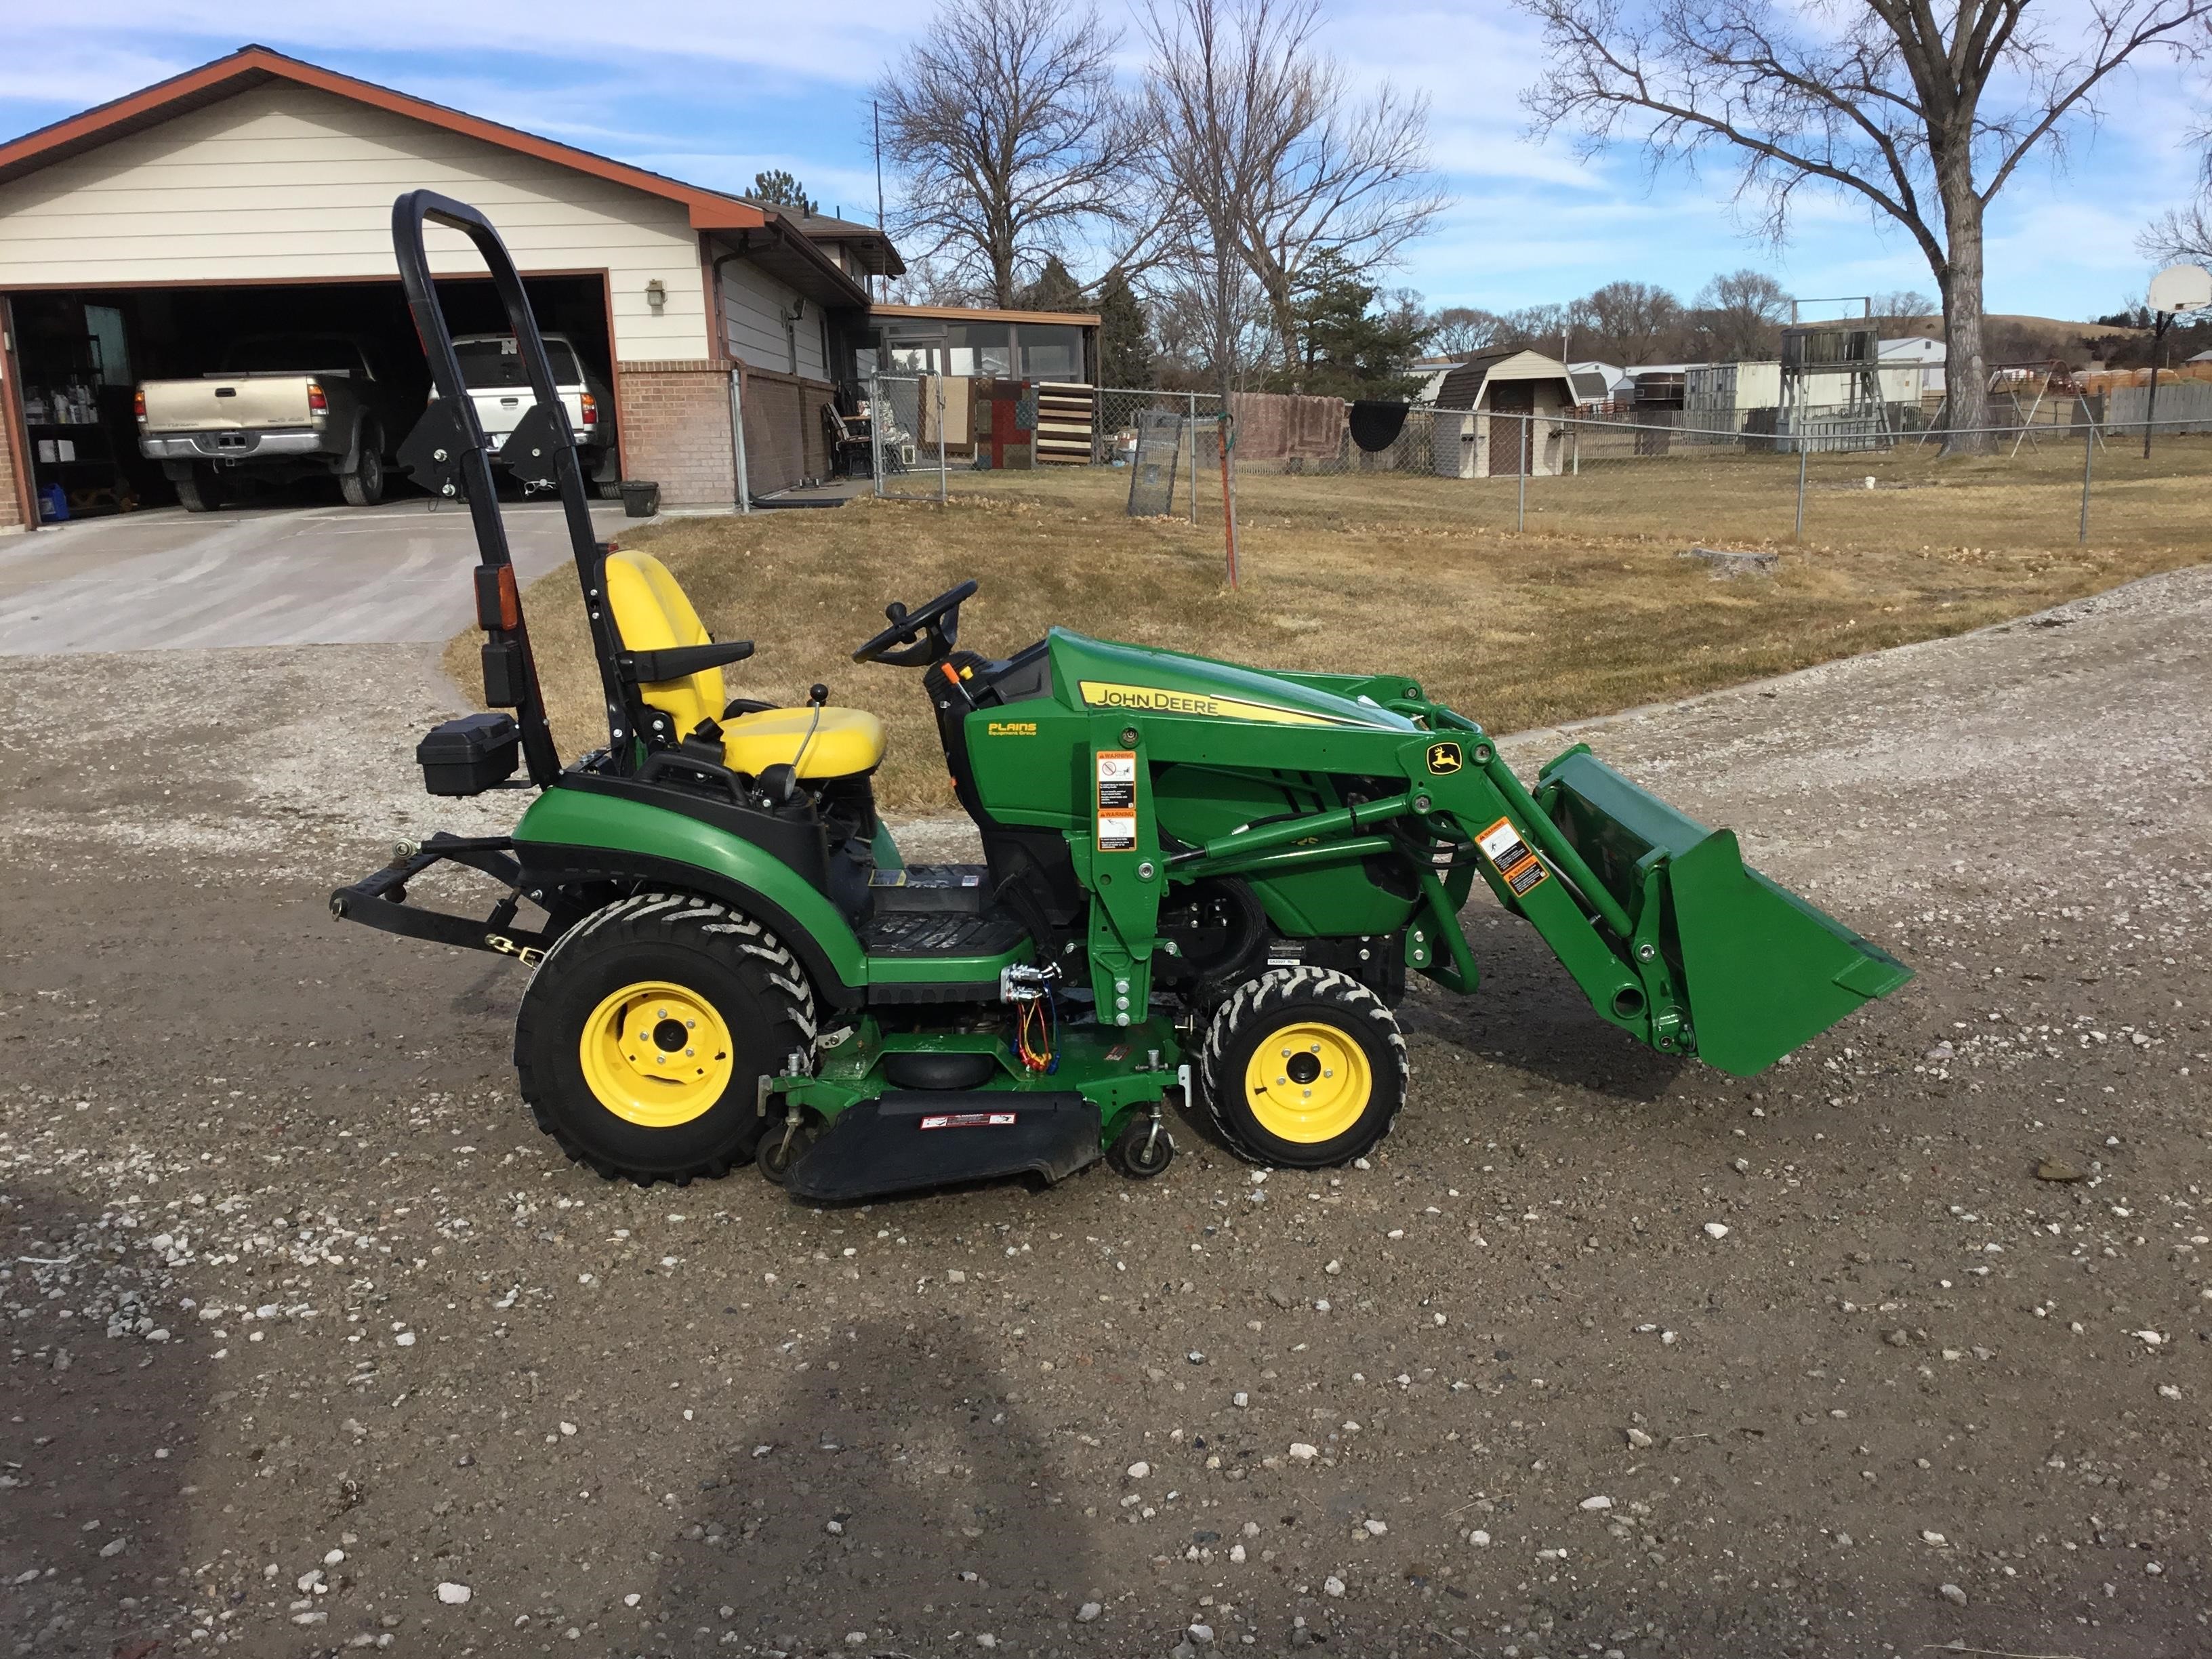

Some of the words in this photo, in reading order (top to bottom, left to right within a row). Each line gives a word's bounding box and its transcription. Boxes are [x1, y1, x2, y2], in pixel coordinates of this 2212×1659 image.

[1097, 689, 1149, 707] JOHN
[1154, 693, 1218, 714] DEERE
[988, 723, 1036, 731] PLAINS
